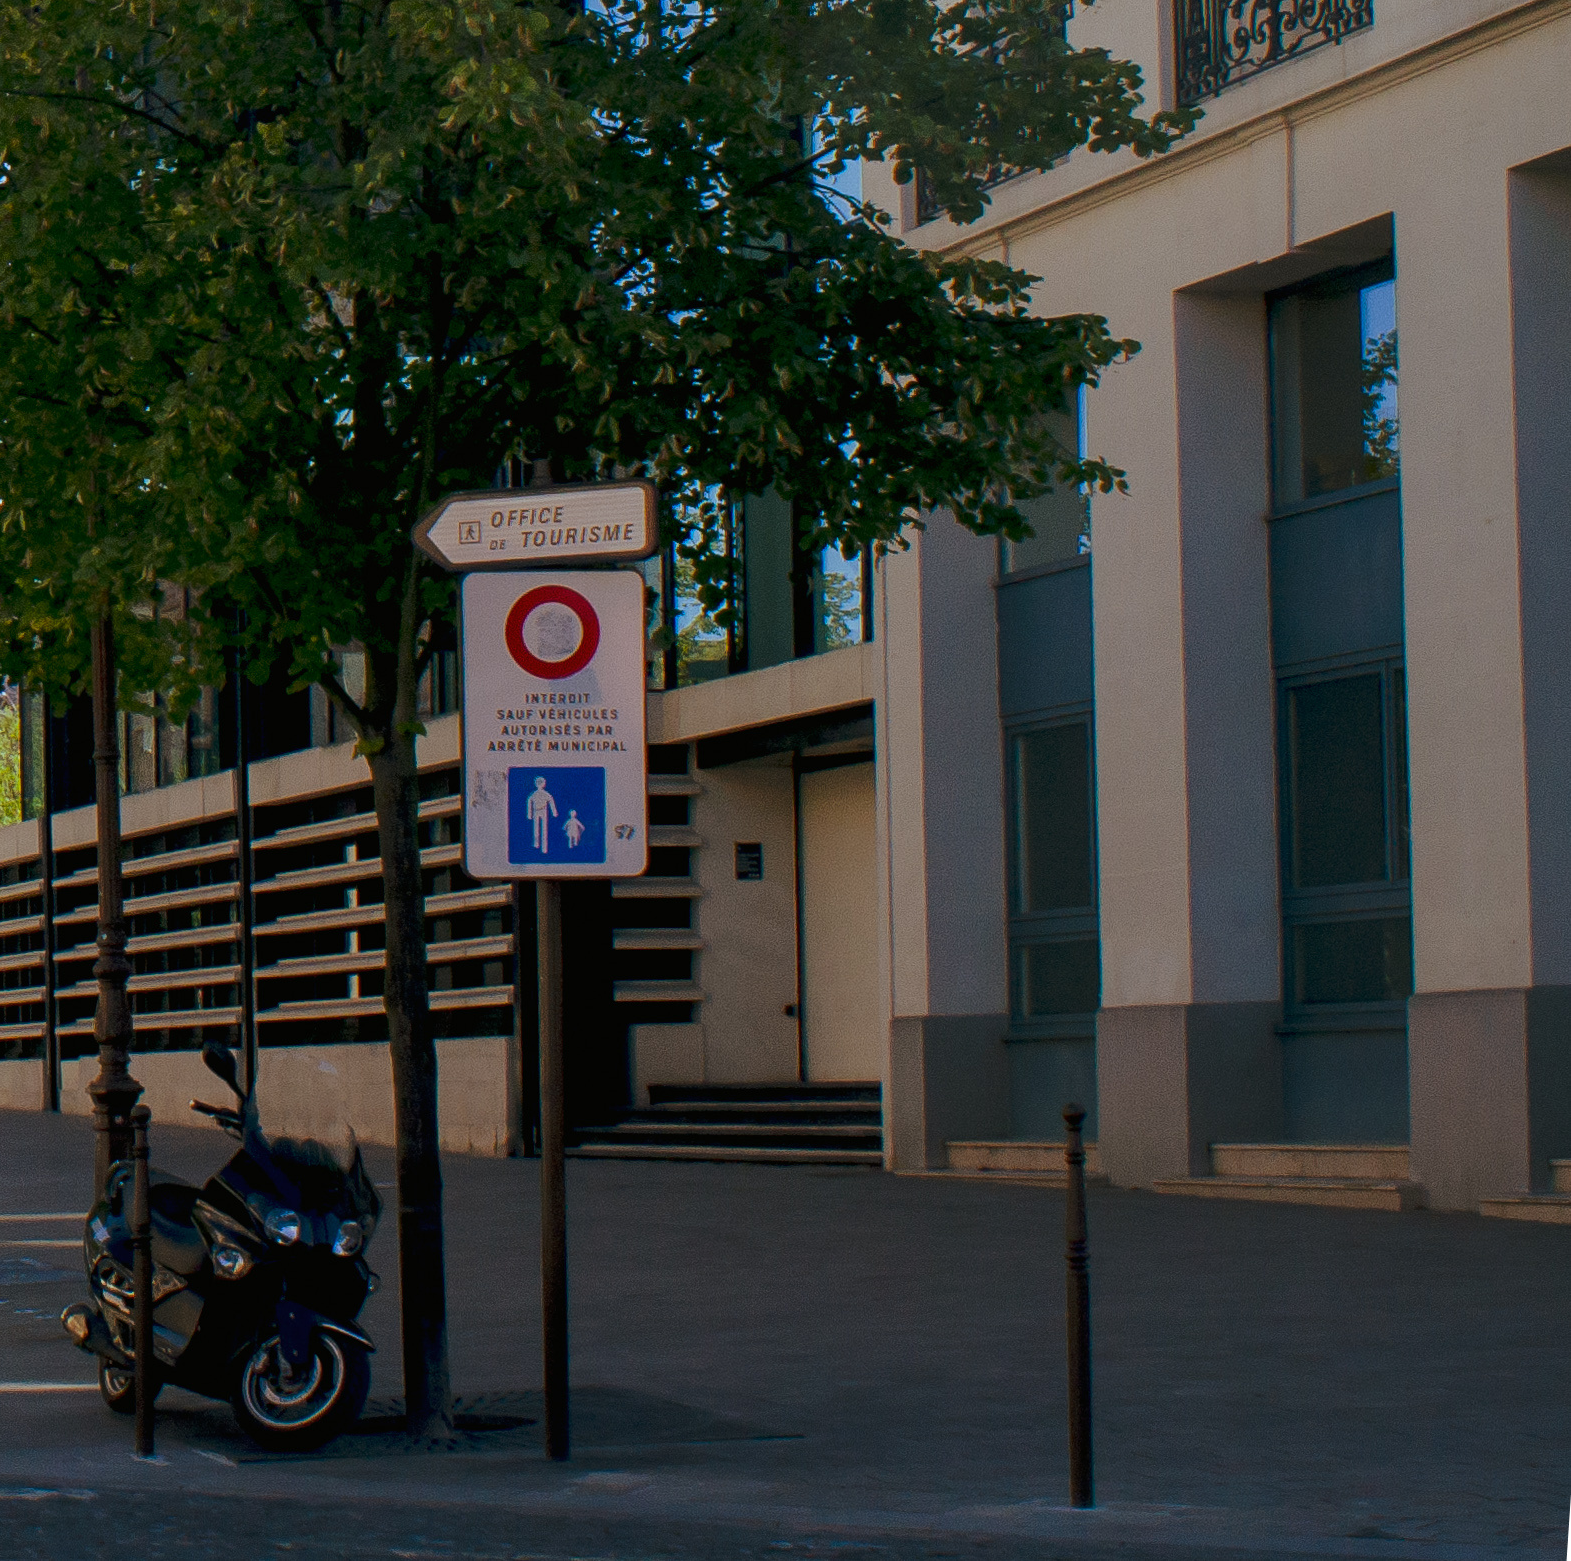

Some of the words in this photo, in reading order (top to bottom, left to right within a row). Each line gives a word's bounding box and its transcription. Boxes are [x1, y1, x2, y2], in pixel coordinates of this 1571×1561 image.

[490, 506, 563, 528] OFFICE
[489, 539, 506, 550] DE
[521, 523, 634, 548] TOURISME
[524, 693, 590, 704] INTERDIT
[496, 709, 534, 720] SAUF
[538, 707, 619, 720] VÉHICULES
[501, 723, 581, 735] AUTORISÉS
[586, 725, 613, 735] PAR
[487, 739, 542, 751] ARRÊTÉ
[547, 741, 627, 751] MUNICIPAL
